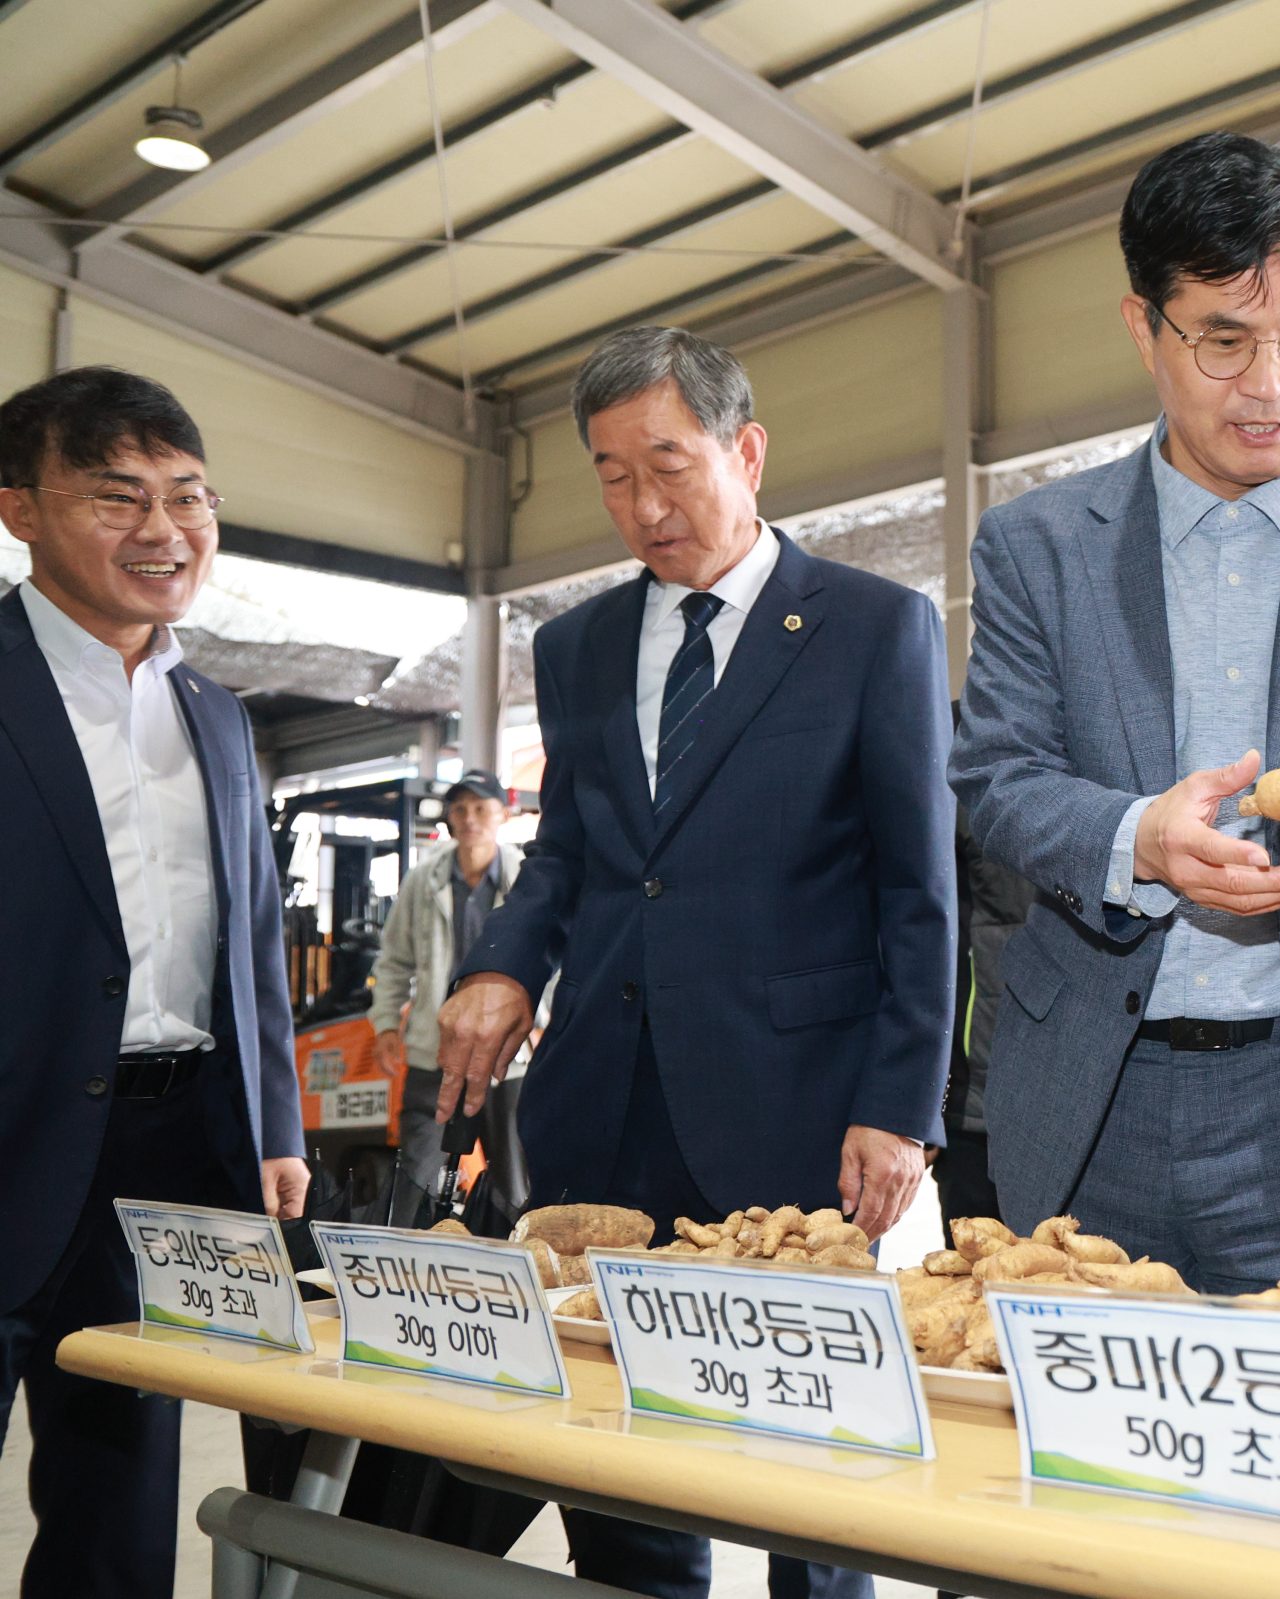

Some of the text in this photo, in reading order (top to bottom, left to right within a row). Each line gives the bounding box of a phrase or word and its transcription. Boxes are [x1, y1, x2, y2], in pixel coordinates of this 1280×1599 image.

[126, 1210, 148, 1220] NH
[137, 1226, 278, 1287] 등외(5등급)
[326, 1235, 354, 1246] NH
[340, 1253, 529, 1324] 종마(4등급)
[606, 1265, 643, 1277] NH
[179, 1280, 258, 1319] 30g 초과
[1011, 1304, 1063, 1318] NH
[394, 1313, 498, 1361] 30g 이하
[622, 1284, 884, 1369] 하마(3등급)
[691, 1358, 834, 1413] 30g 초과
[1125, 1416, 1206, 1477] 50g
